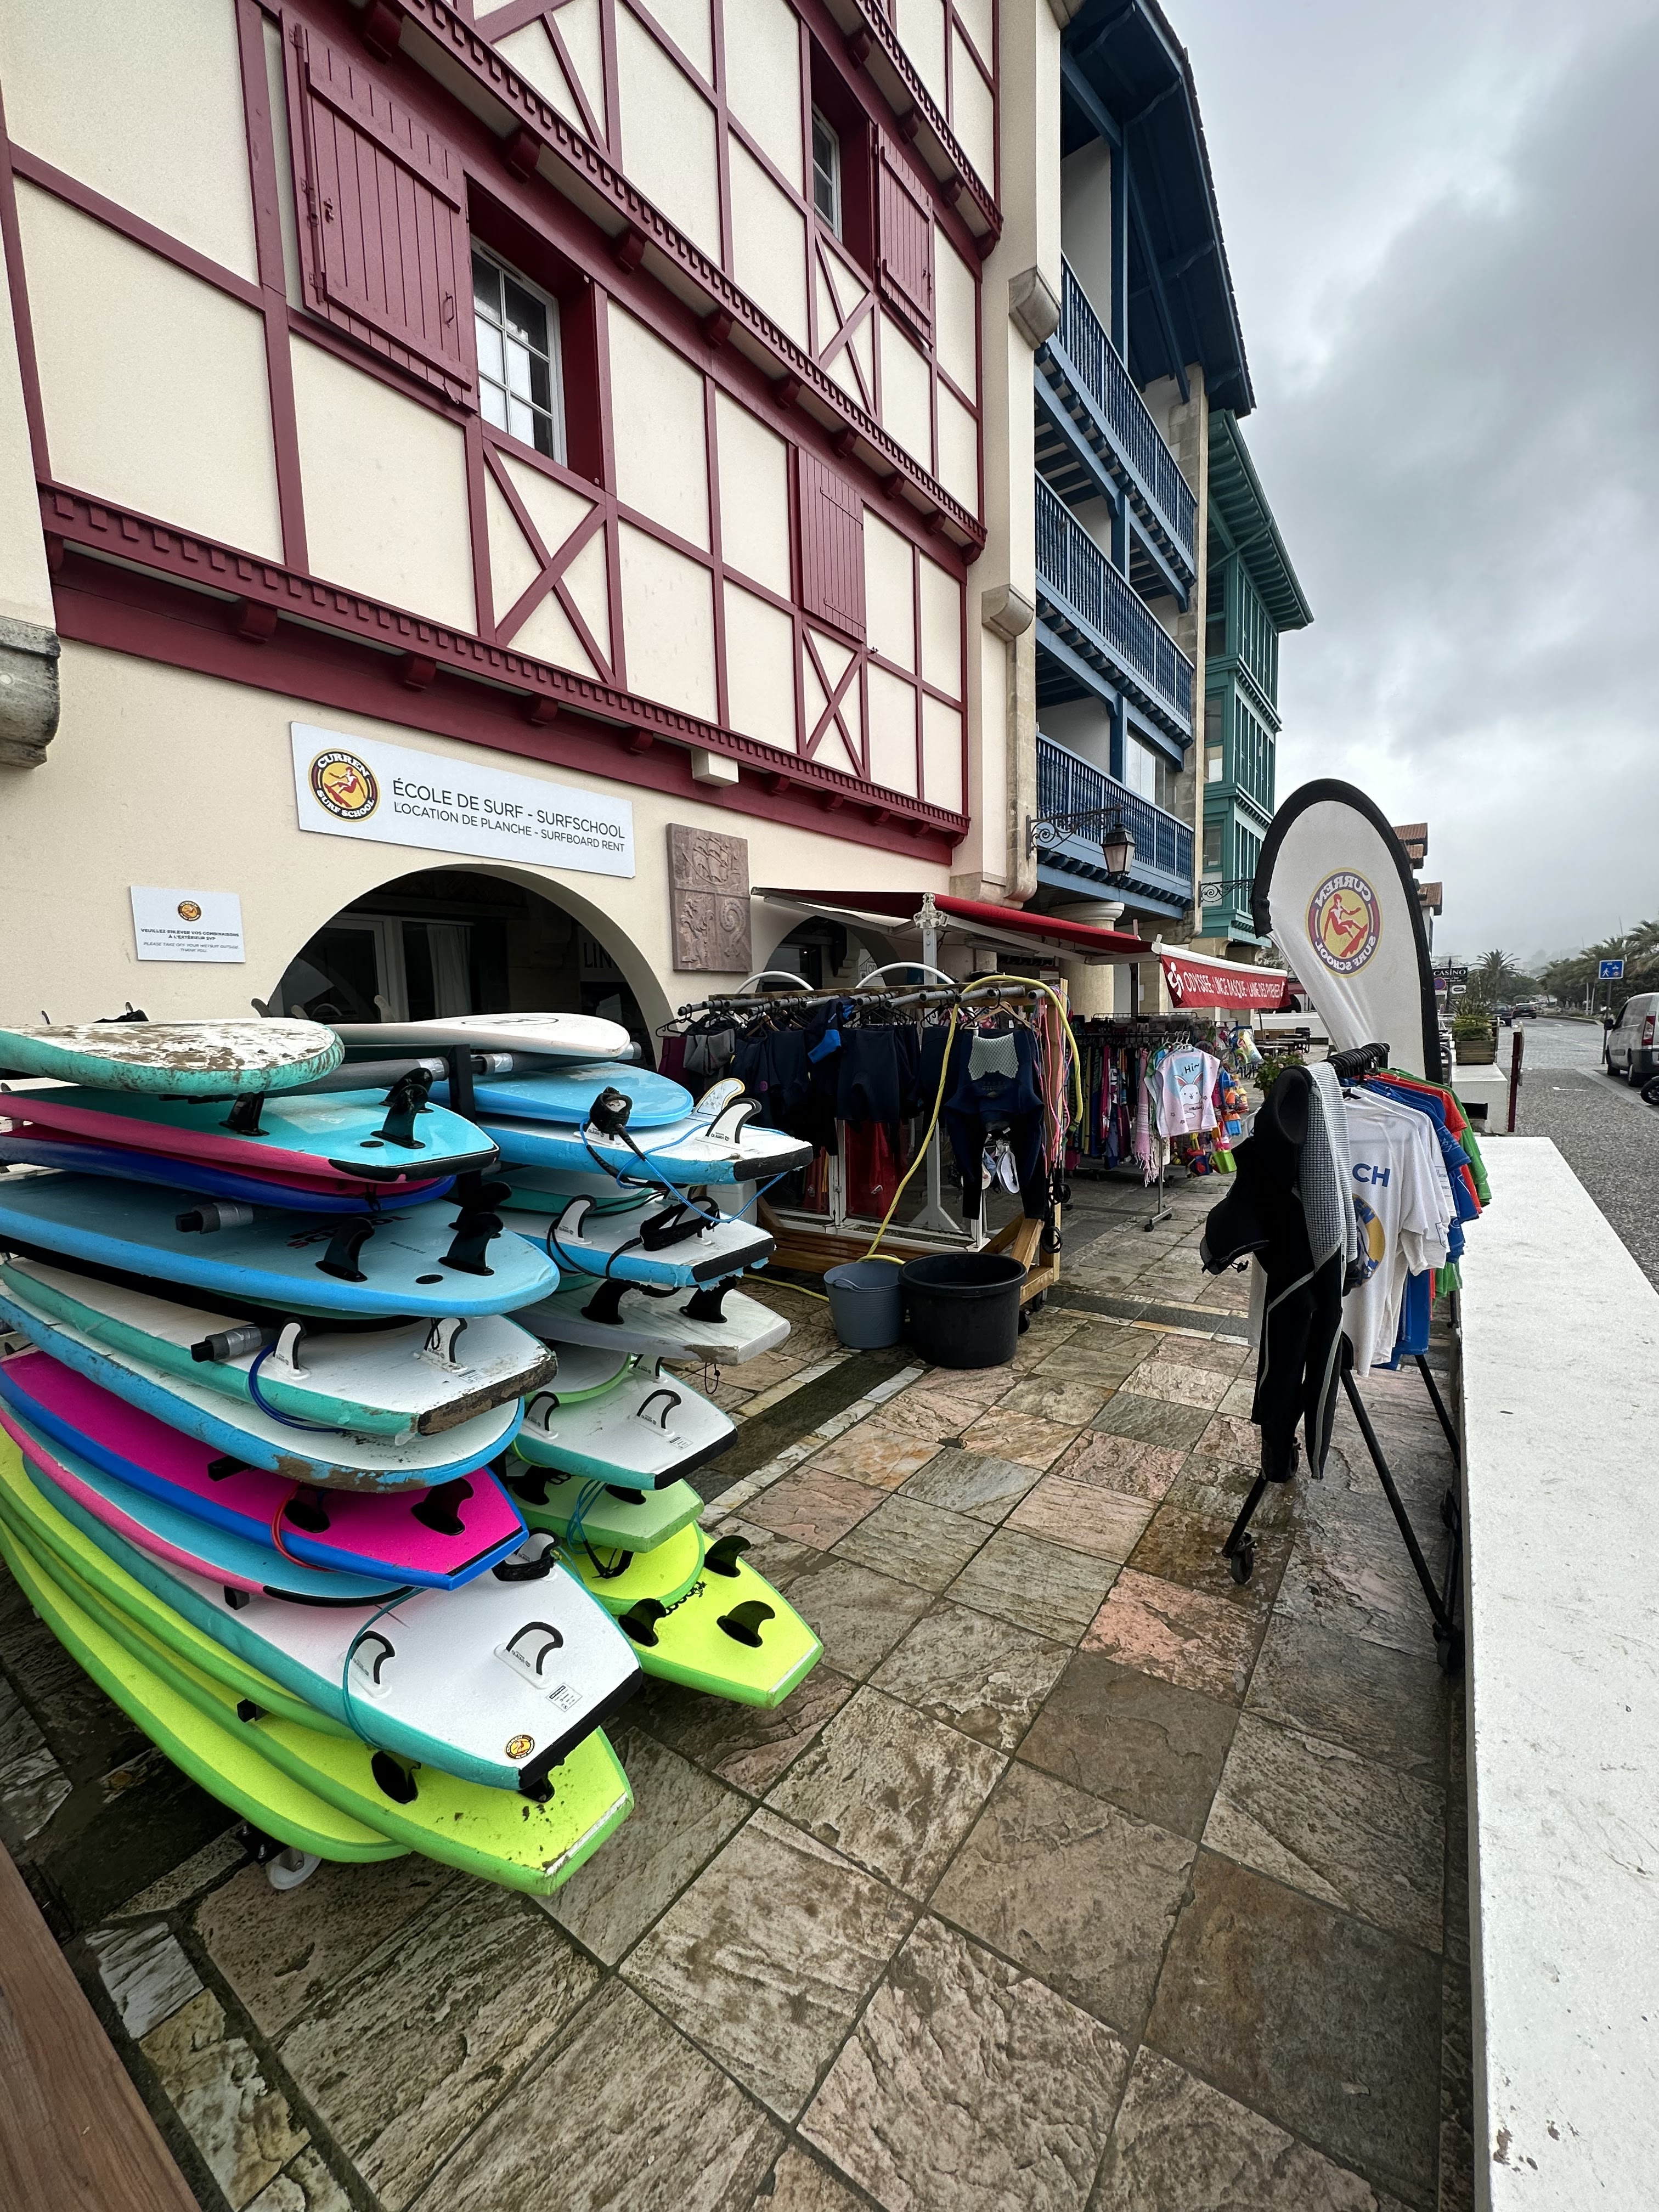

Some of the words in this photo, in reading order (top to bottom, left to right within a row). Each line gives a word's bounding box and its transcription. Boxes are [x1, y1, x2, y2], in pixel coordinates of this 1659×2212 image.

[317, 753, 370, 777] CURREN
[317, 789, 341, 813] SURF
[341, 799, 375, 817] SCHOOL
[393, 777, 453, 806] ÉCOLE
[458, 793, 479, 811] DE
[484, 799, 523, 818] SURF
[537, 810, 625, 839] SURFSCHOOL
[394, 802, 459, 823] LOCATION
[462, 814, 478, 827] DE
[481, 817, 532, 836] PLANCHE
[541, 829, 600, 848] SURFBOARD
[602, 840, 625, 852] RENT
